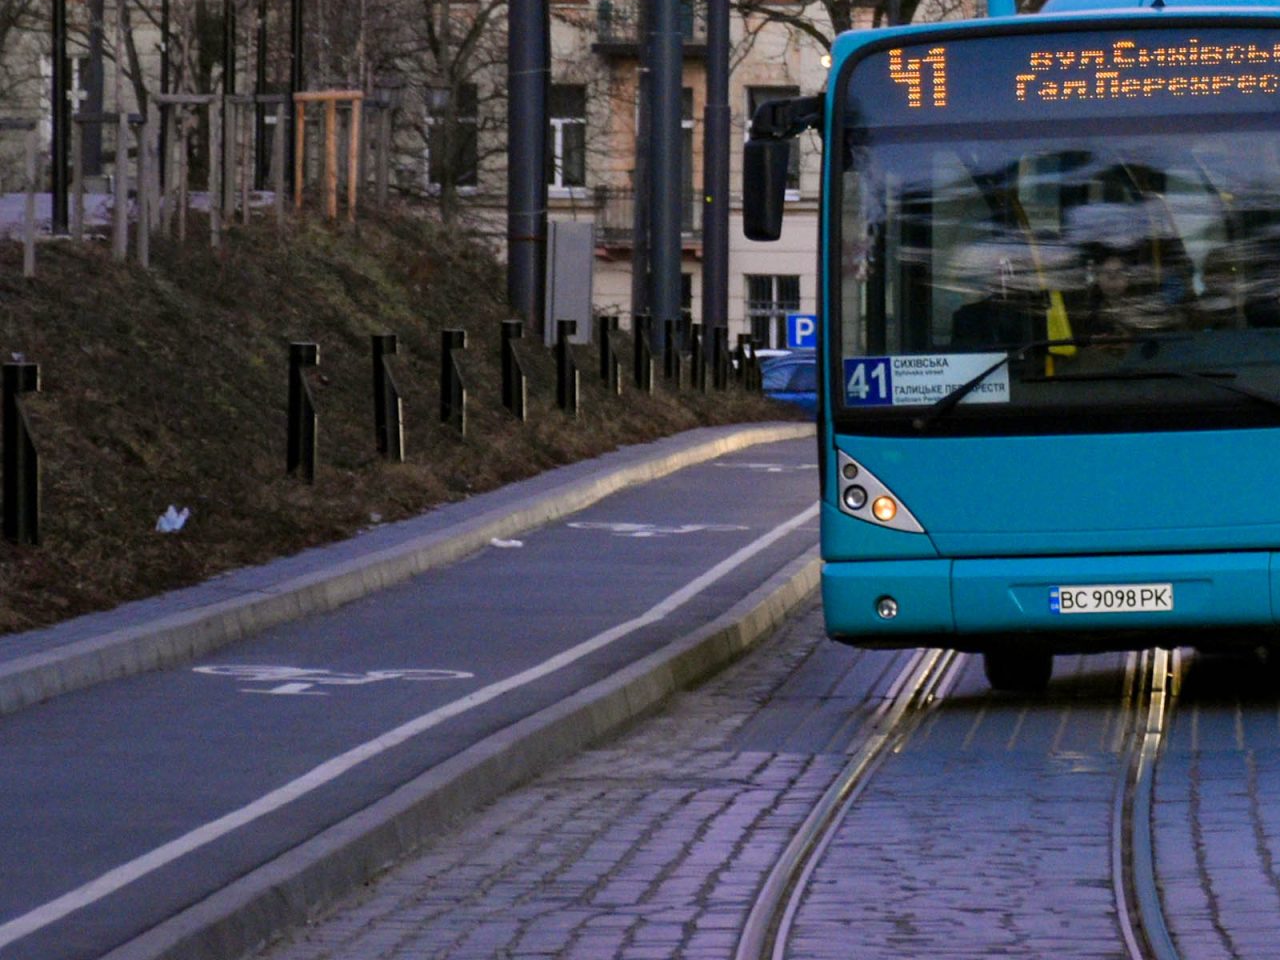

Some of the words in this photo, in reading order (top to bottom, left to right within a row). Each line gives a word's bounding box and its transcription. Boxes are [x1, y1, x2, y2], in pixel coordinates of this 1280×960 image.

[889, 47, 946, 107] 41
[796, 318, 815, 345] P
[894, 358, 949, 369] СИХІВСЬКА
[847, 362, 887, 399] 41
[894, 384, 943, 396] ГАЛИЦЬКЕ
[1061, 591, 1088, 609] BC
[1092, 590, 1137, 608] 9098
[1140, 588, 1168, 607] PK
